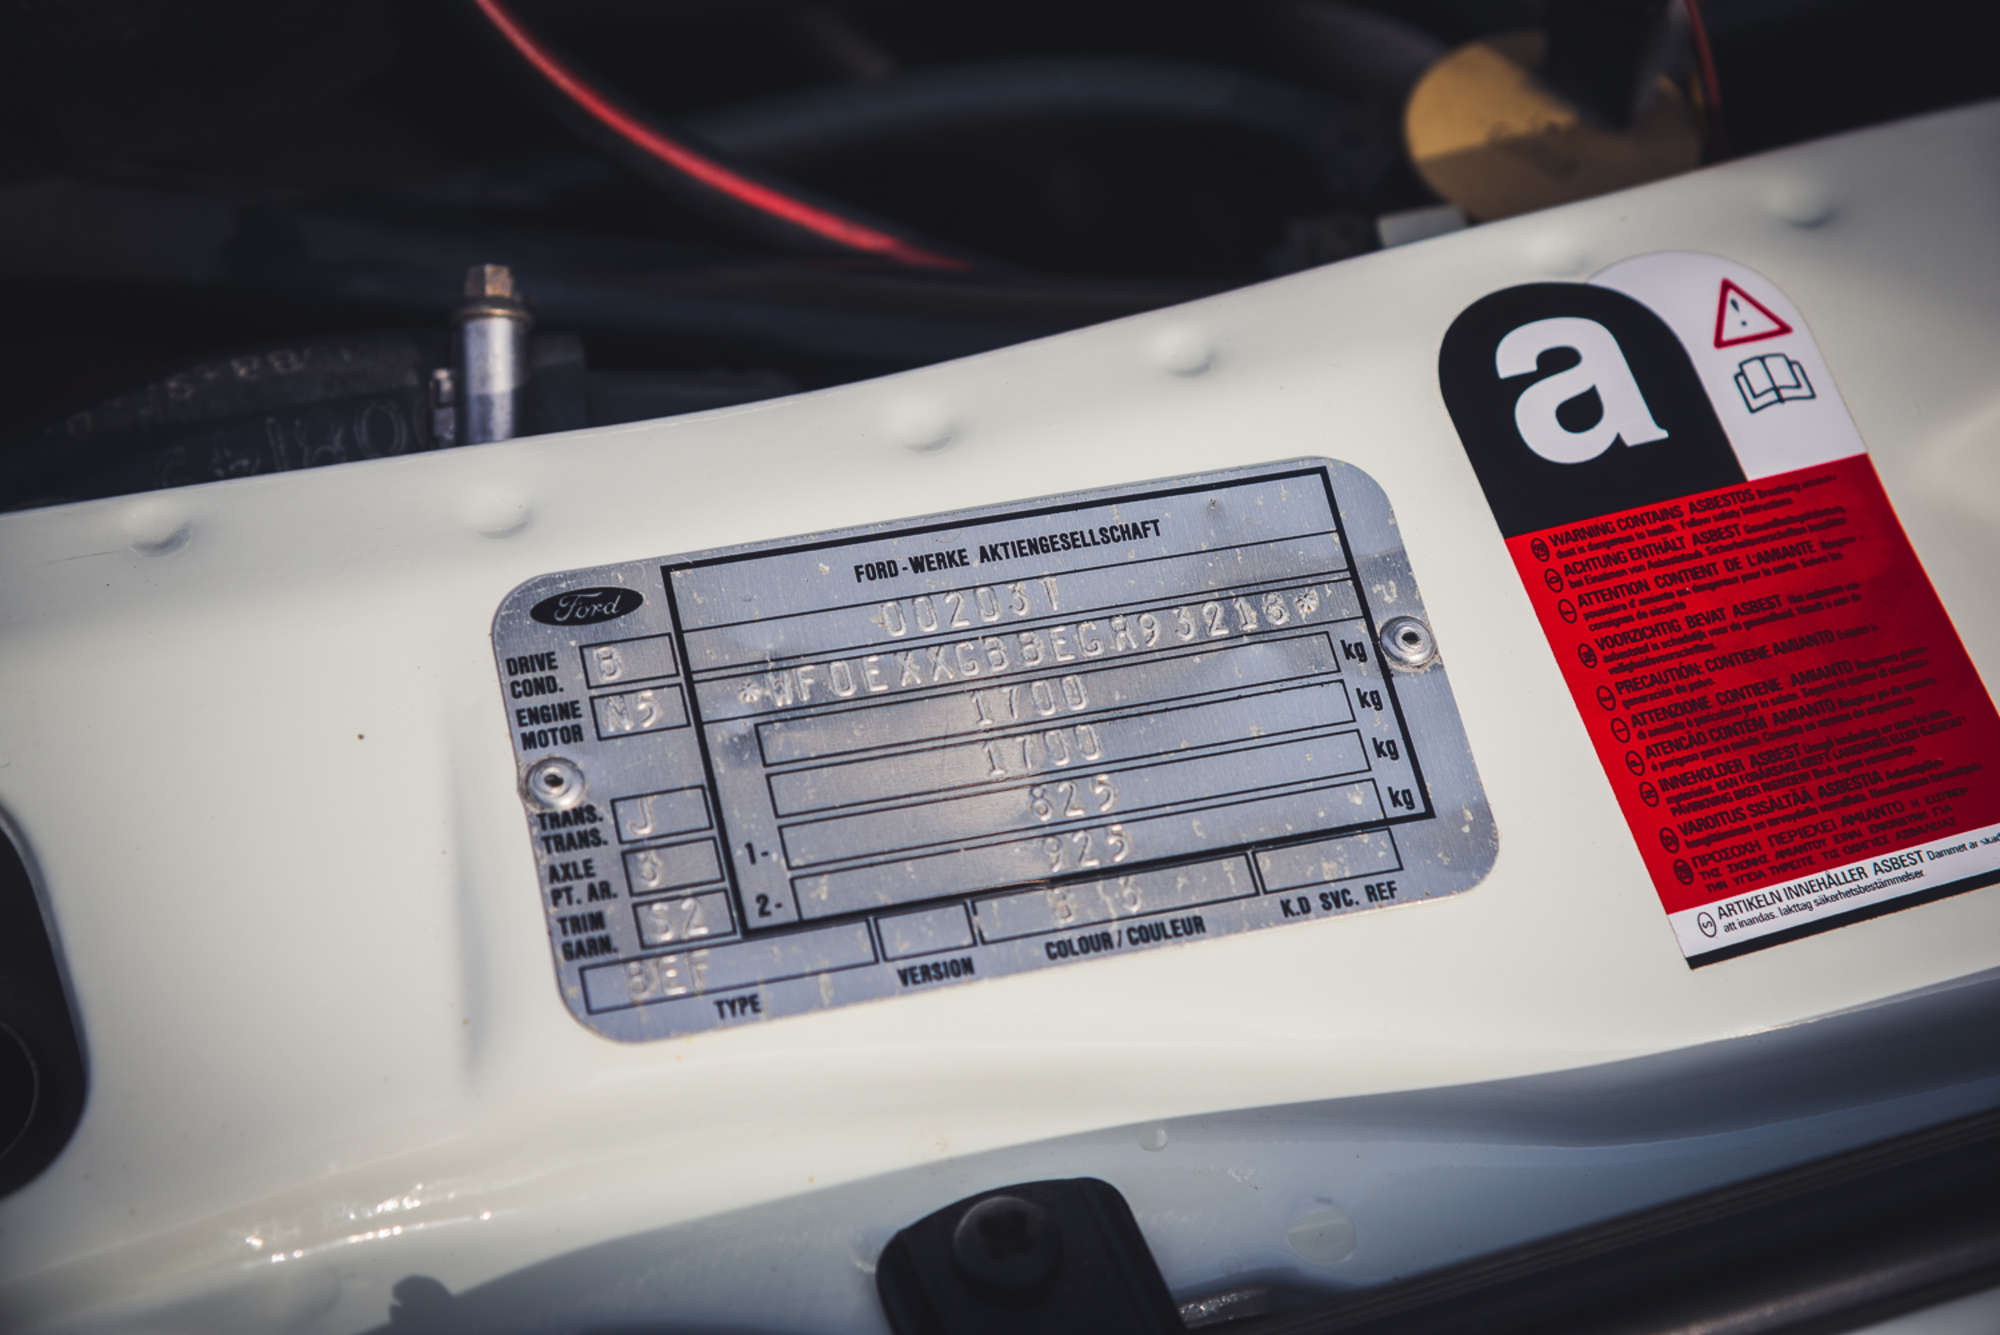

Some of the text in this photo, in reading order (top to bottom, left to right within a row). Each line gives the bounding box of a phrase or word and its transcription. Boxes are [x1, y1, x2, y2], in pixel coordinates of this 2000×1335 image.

[1495, 317, 1669, 463] a
[1547, 520, 1616, 547] WARNING
[1616, 504, 1685, 531] CONTAINS
[1687, 487, 1755, 514] ASBESTOS
[977, 517, 1162, 563] AKTIENGESELLSCHAFT
[1562, 550, 1628, 577] ACHTUNG
[1626, 533, 1687, 561] ENTHÄLT
[1690, 523, 1742, 546] ASBEST
[1575, 578, 1650, 607] ATTENTION
[1653, 561, 1720, 589] CONTIENT
[1723, 556, 1743, 572] DE
[1745, 539, 1816, 567] L'AMIANTE
[550, 586, 625, 623] Ford
[1594, 618, 1683, 652] VOORZICHTIG
[1684, 607, 1727, 629] BEVAT
[1730, 594, 1782, 618] ASBEST
[506, 651, 558, 676] DRIVE
[1613, 660, 1704, 694] PRECAUTIÓN:
[1703, 644, 1771, 673] CONTIENE
[1770, 628, 1835, 656] AMIANTO
[510, 674, 564, 700] COND.
[969, 637, 1368, 726] 1700 kg
[1629, 695, 1712, 728] ATTENZIONE
[1714, 676, 1783, 706] CONTIENE
[1788, 658, 1853, 687] AMIANTO
[516, 700, 582, 727] ENGINE
[1770, 698, 1836, 726] AMIANTO
[521, 724, 583, 751] MOTOR
[981, 685, 1383, 777] 1700 kg
[1027, 773, 1122, 822] 825
[1371, 734, 1399, 762] kg
[1657, 757, 1745, 792] INNEHOLDER
[1748, 743, 1802, 768] ASBEST
[536, 803, 603, 831] TRANS.
[1677, 806, 1747, 836] VAROITUS
[1815, 769, 1884, 799] ASBESTIA
[541, 826, 608, 855] TRANS.
[1041, 824, 1134, 873] 925
[1387, 783, 1415, 812] kg
[546, 859, 595, 884] AXLE
[1691, 839, 1762, 869] ΠΡΟΣΟΧΗ
[551, 880, 618, 908] PT. AR.
[1715, 890, 1782, 919] ARTIKELN
[1782, 864, 1868, 900] INNEHÅLLER
[1871, 849, 1925, 875] ASBEST
[1926, 840, 1967, 861] Dammet
[1280, 880, 1399, 917] K.D SVC. REF
[558, 911, 606, 936] TRIM
[1722, 922, 1737, 932] att
[561, 933, 618, 961] GARN.
[897, 956, 975, 987] VERSION
[714, 993, 762, 1019] TYPE
